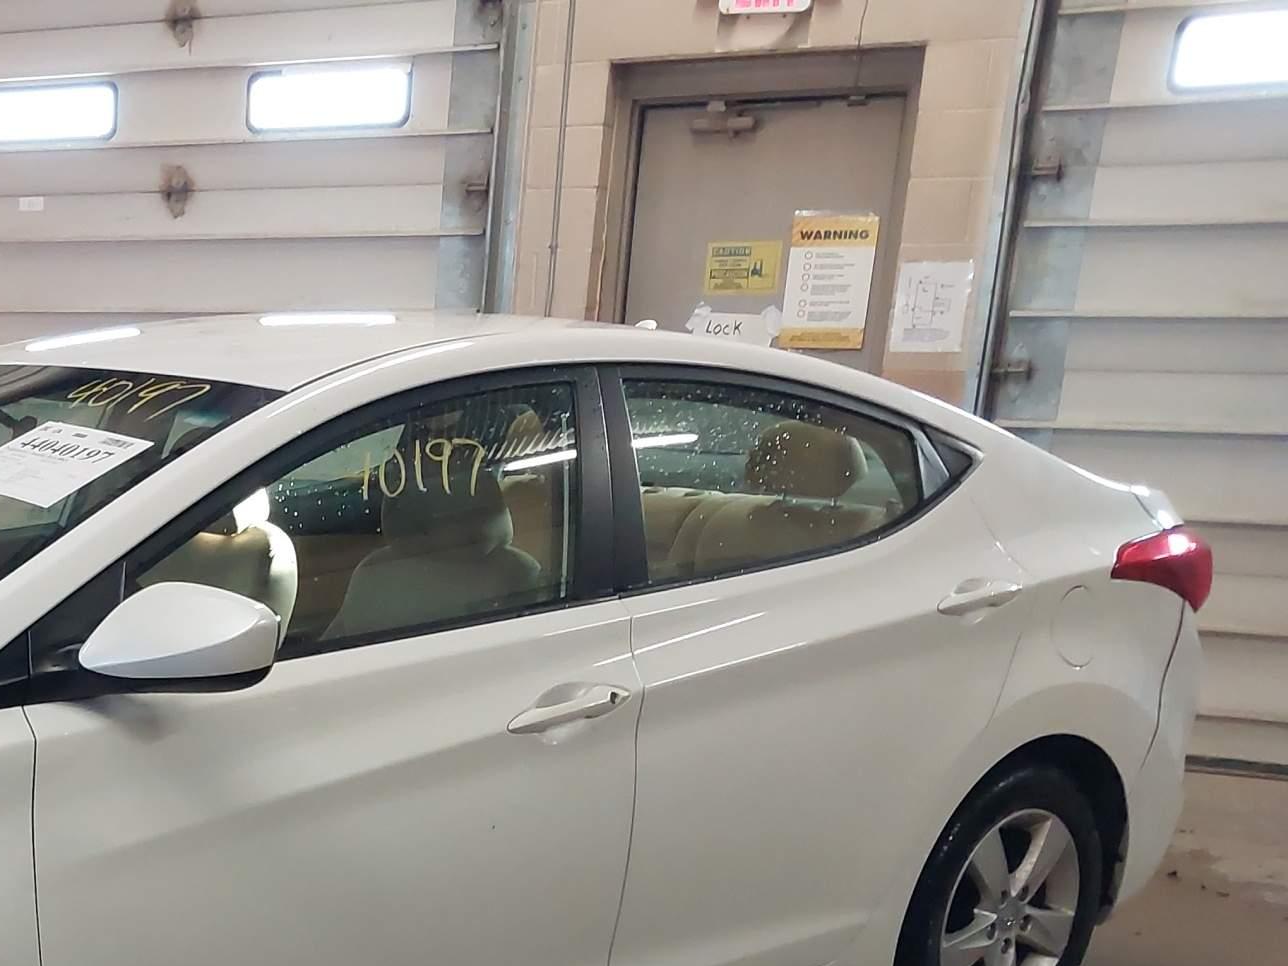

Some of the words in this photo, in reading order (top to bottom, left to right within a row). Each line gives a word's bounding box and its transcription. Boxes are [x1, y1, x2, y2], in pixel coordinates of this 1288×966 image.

[800, 230, 869, 240] WARNING
[705, 320, 742, 335] LOCK
[20, 436, 115, 463] 44040197
